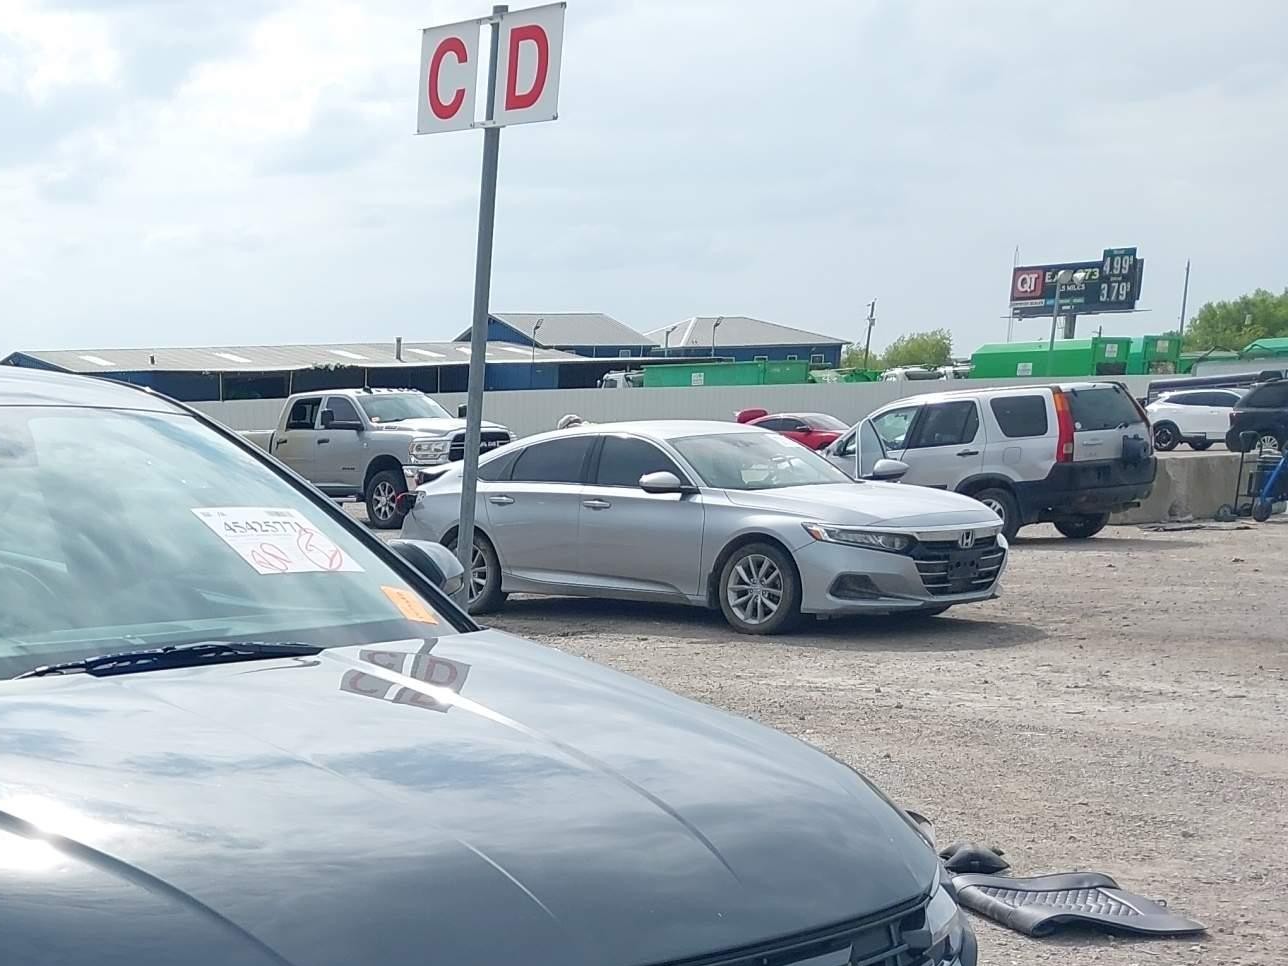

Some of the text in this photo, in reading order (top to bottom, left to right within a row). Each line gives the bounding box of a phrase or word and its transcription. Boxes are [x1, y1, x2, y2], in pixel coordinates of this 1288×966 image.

[428, 24, 549, 120] C D
[1017, 273, 1039, 293] QT
[223, 520, 308, 535] 45425771
